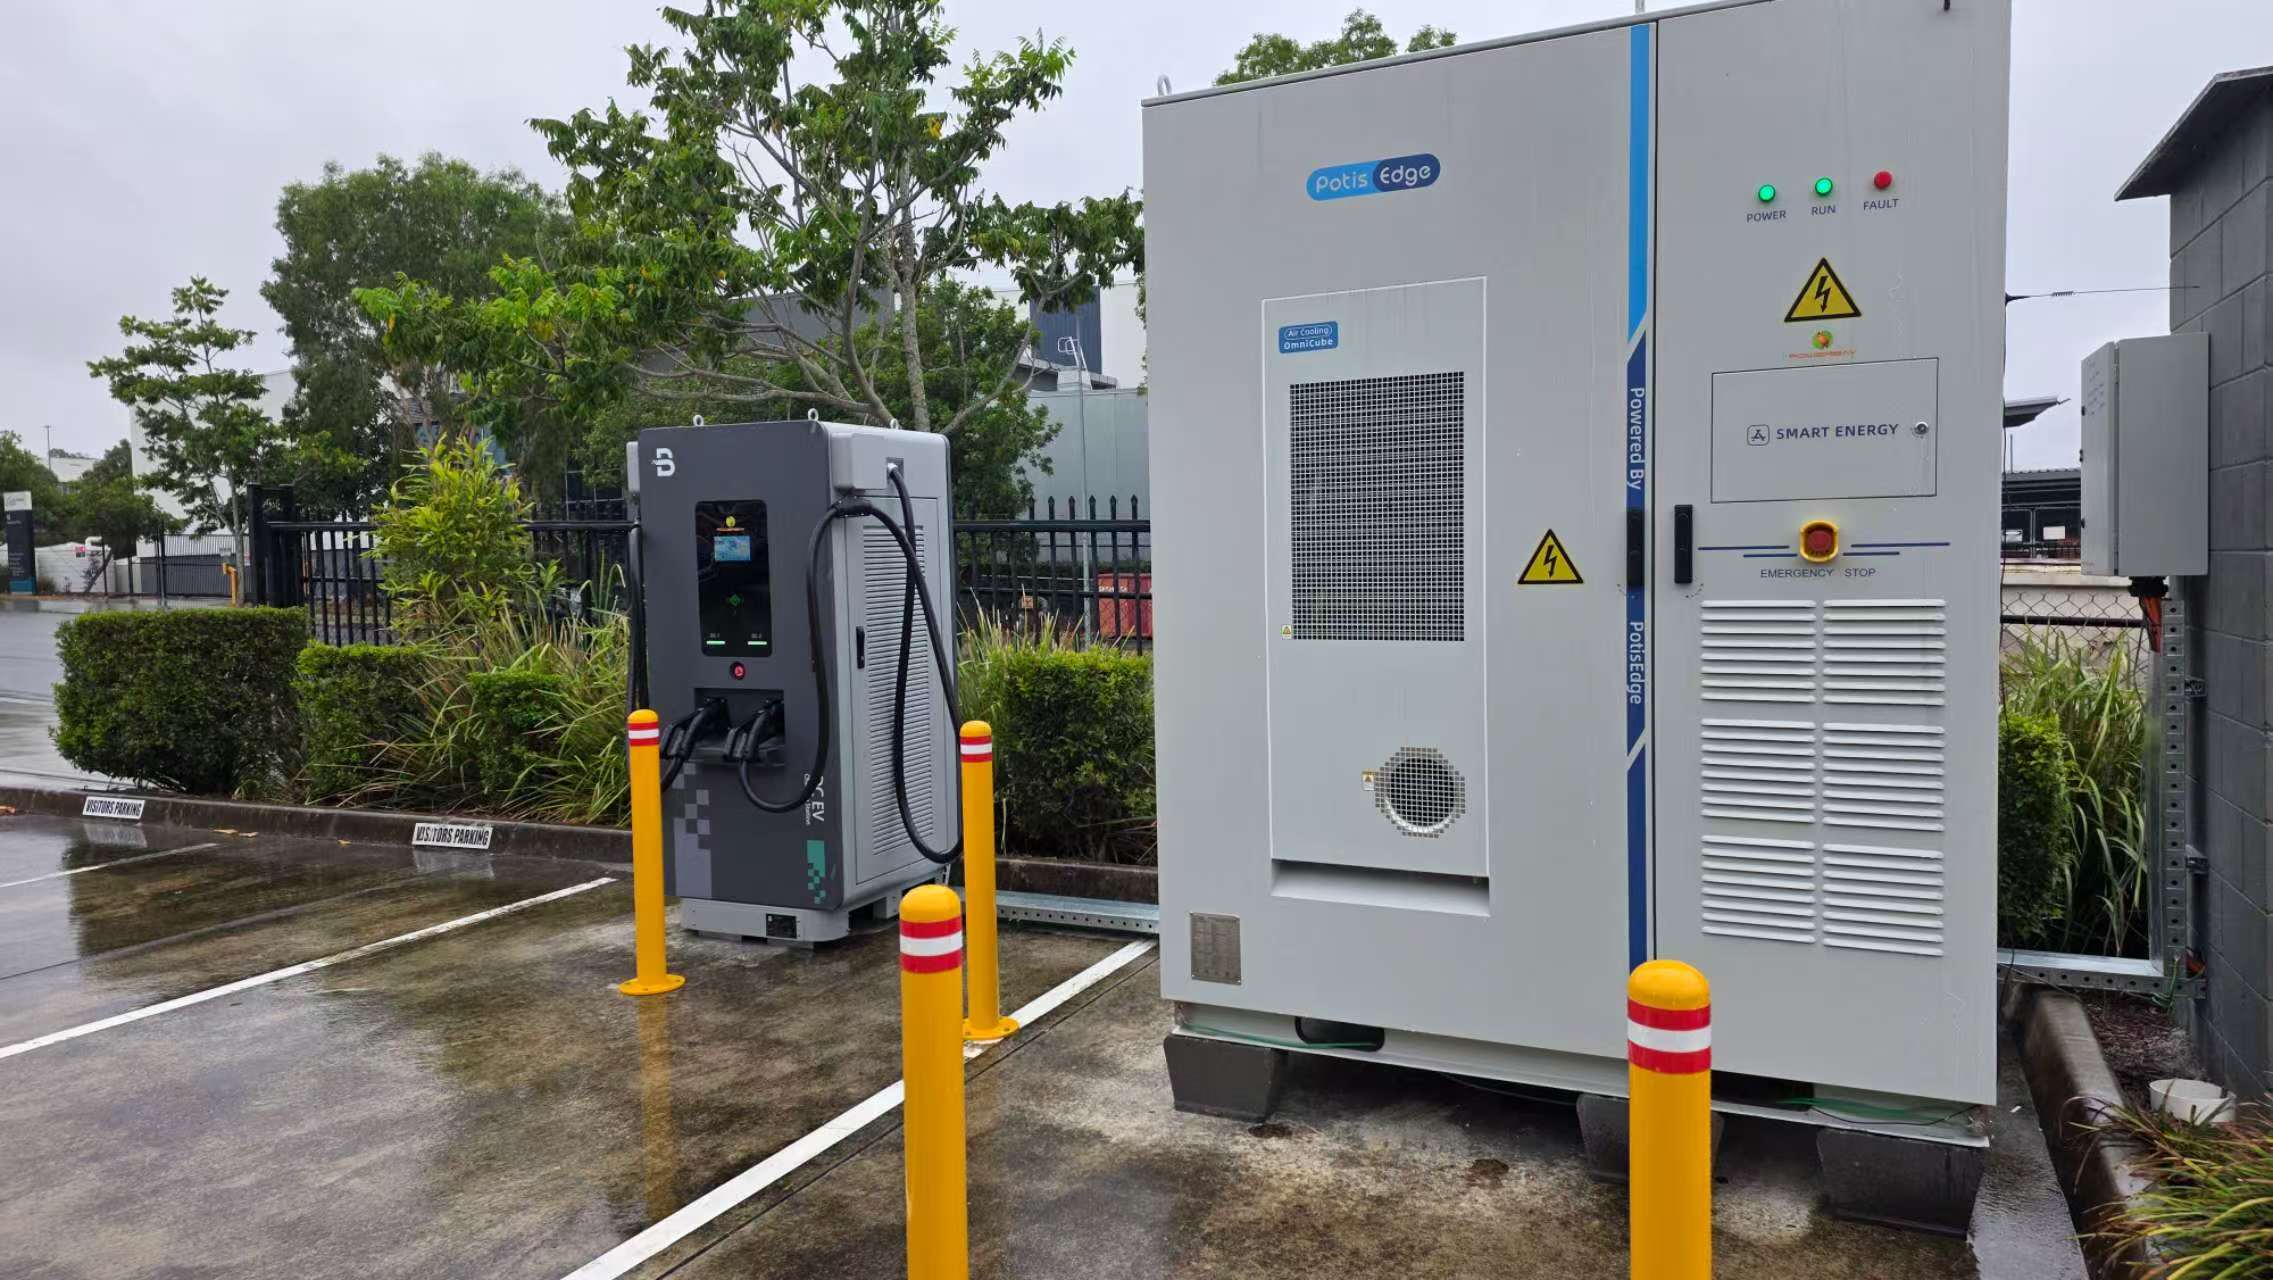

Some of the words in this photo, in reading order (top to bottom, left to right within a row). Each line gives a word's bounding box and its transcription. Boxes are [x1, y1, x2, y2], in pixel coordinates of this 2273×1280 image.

[1379, 165, 1432, 187] Edge
[1811, 205, 1836, 216] RUN
[1863, 198, 1899, 211] FAULT
[1746, 210, 1787, 223] POWER
[1288, 328, 1299, 337] Air
[1300, 327, 1330, 336] Cooling
[1283, 338, 1334, 350] OmniCube
[1629, 387, 1645, 464] Powered
[1776, 426, 1830, 440] SMART
[1835, 423, 1899, 438] ENERGY
[1627, 468, 1645, 490] By
[1760, 568, 1835, 579] EMERGENCY
[1844, 567, 1877, 578] STOP
[1627, 621, 1645, 705] PotisEdge
[86, 799, 115, 815] VISITORS
[115, 801, 142, 817] PARKING
[811, 801, 825, 822] EV
[416, 826, 454, 843] VISITORS
[453, 828, 490, 846] PARKING
